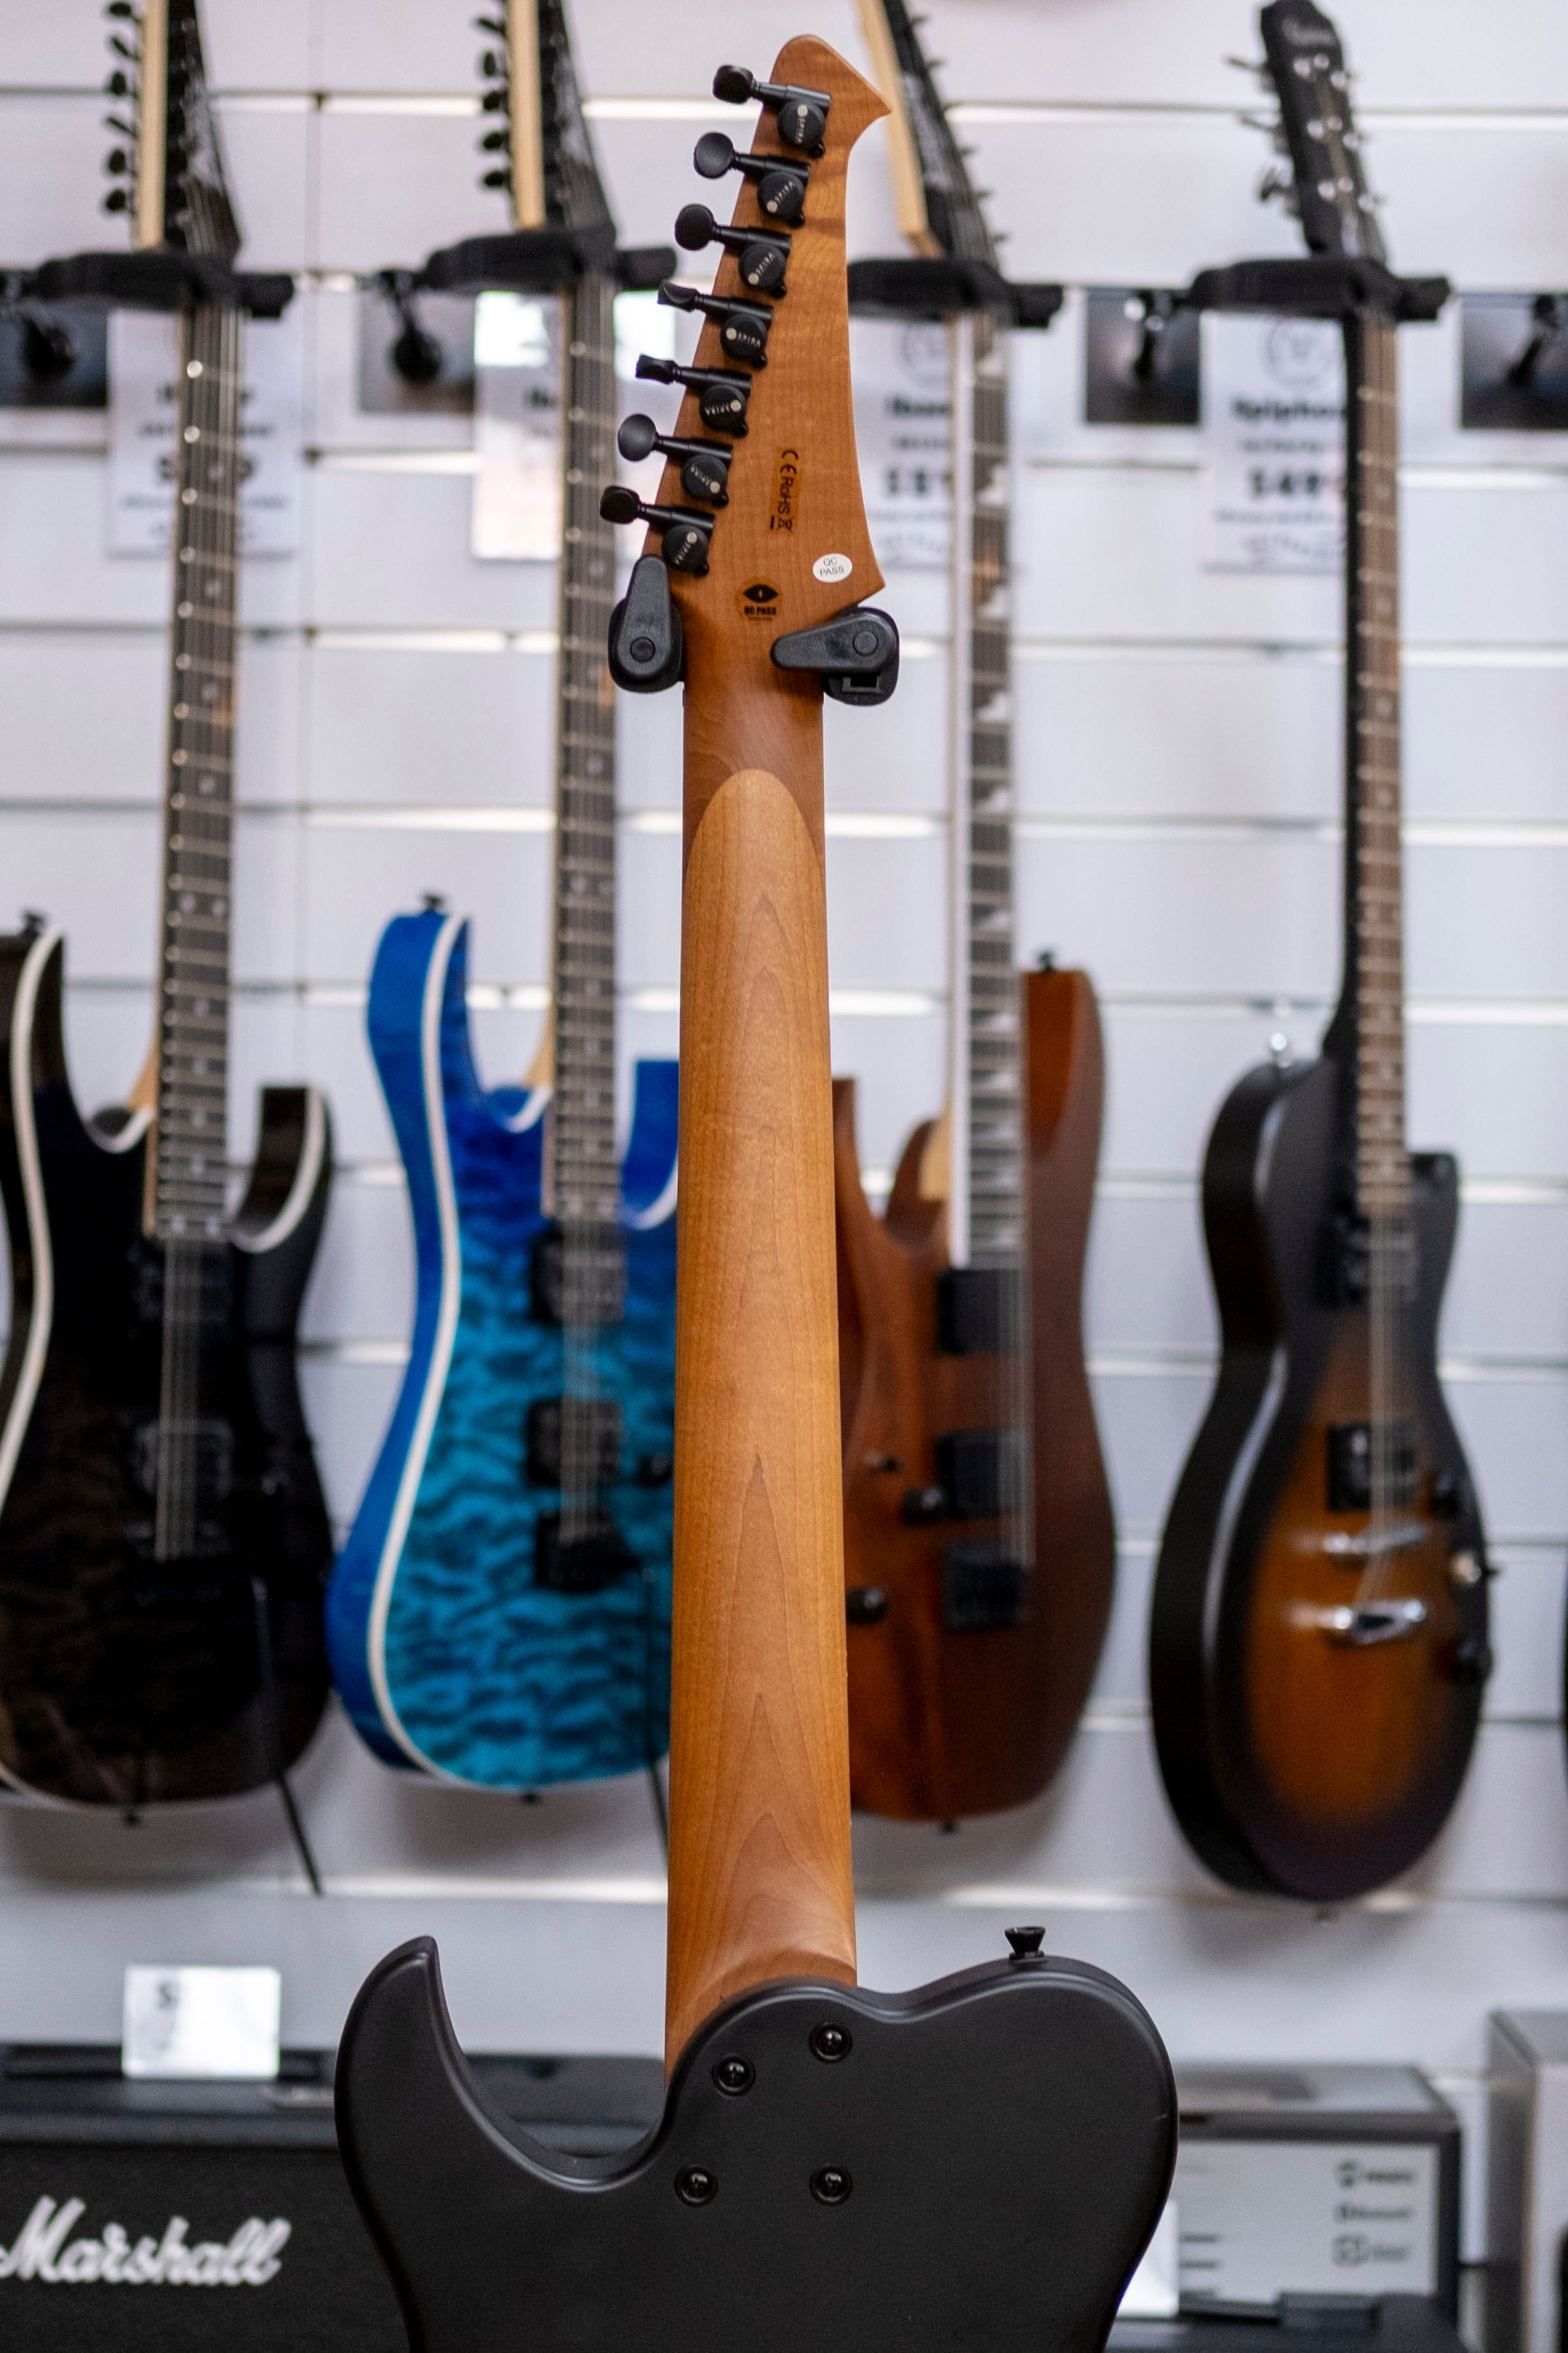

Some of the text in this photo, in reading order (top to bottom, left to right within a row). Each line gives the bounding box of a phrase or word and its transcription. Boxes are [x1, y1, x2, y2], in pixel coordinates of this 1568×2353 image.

[823, 556, 837, 567] QC
[820, 566, 844, 577] PASS
[743, 606, 777, 616] QC PASS
[0, 2195, 292, 2287] Marshall
